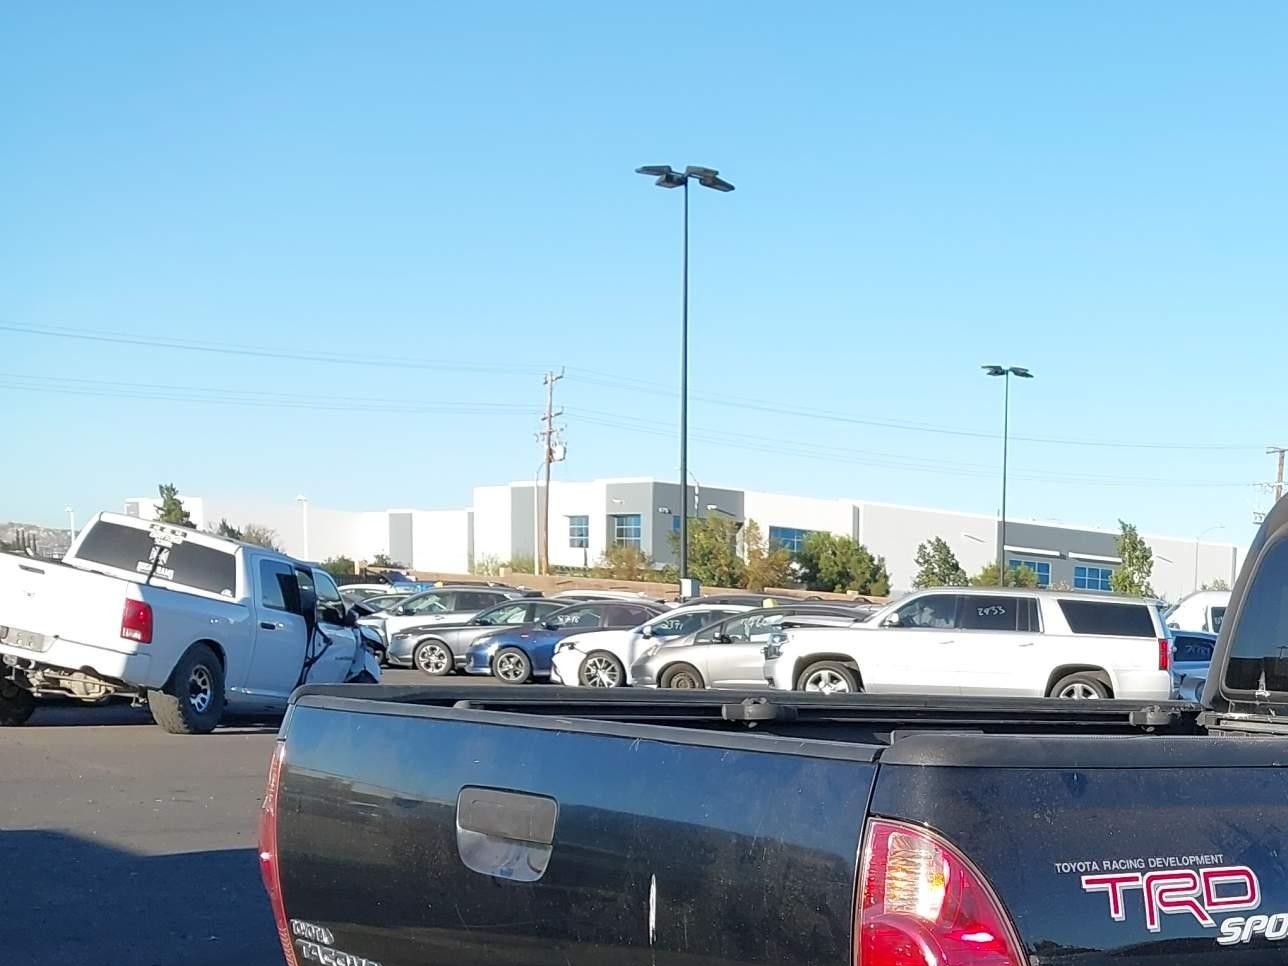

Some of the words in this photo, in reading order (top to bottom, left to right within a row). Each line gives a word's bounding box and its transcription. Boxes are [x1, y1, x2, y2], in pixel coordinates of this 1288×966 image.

[1054, 861, 1100, 873] TOYOTA
[1103, 858, 1146, 871] RACING
[1148, 854, 1224, 869] DEVELOPMENT
[1080, 865, 1262, 933] TRD
[290, 918, 335, 945] TOYOTA
